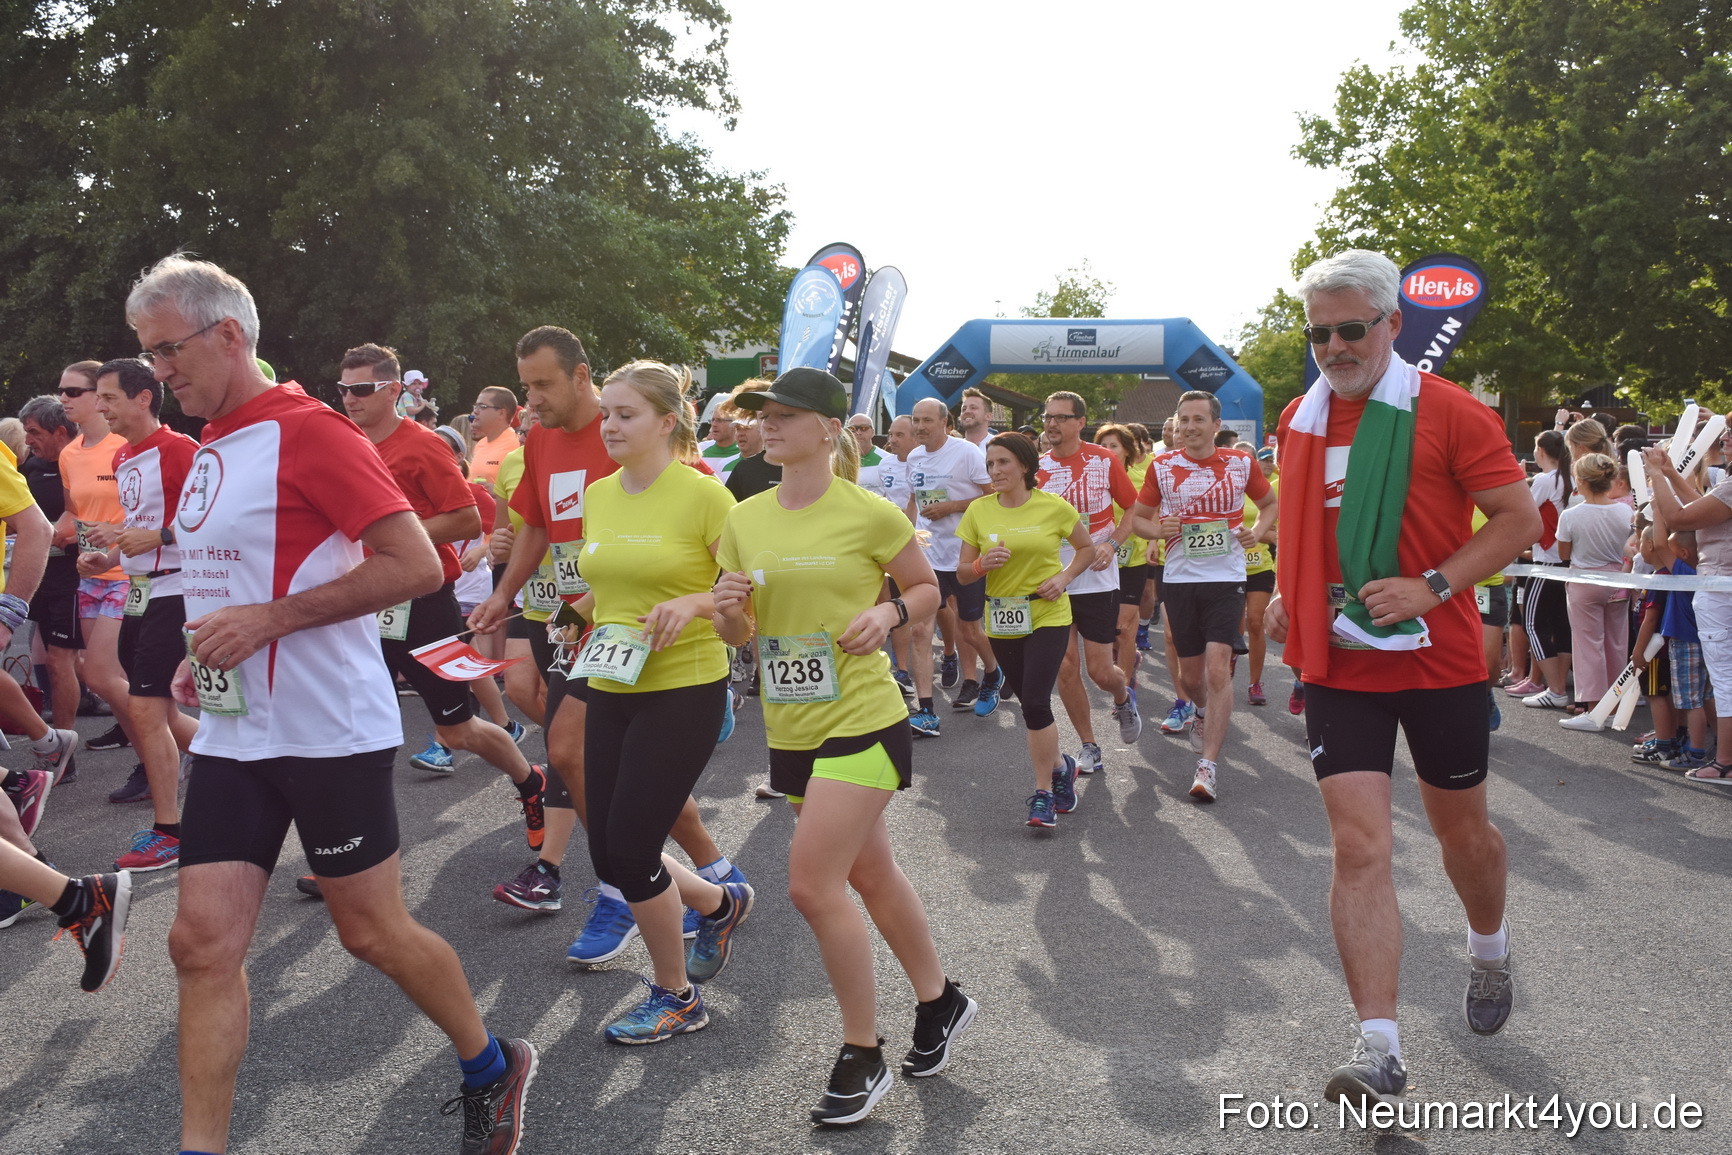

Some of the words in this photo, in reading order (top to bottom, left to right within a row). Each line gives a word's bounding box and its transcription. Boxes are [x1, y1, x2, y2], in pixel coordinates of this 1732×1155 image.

[1409, 275, 1474, 300] Hervis
[881, 289, 898, 338] AUTOMOBILE
[1056, 346, 1121, 358] firmenlauf
[934, 367, 969, 375] Fischer
[135, 514, 155, 522] HERZ
[1188, 533, 1224, 548] 2233
[189, 549, 203, 560] MIT
[206, 545, 242, 561] HERZ
[202, 569, 229, 579] Röschl
[530, 581, 560, 599] 130
[993, 610, 1024, 624] 1280
[583, 643, 633, 667] 1211
[583, 662, 602, 670] Diepold
[602, 663, 618, 671] Ruth
[767, 658, 824, 685] 1238
[775, 685, 794, 694] Herzog
[794, 684, 819, 692] Jessica
[314, 843, 355, 856] JAKO
